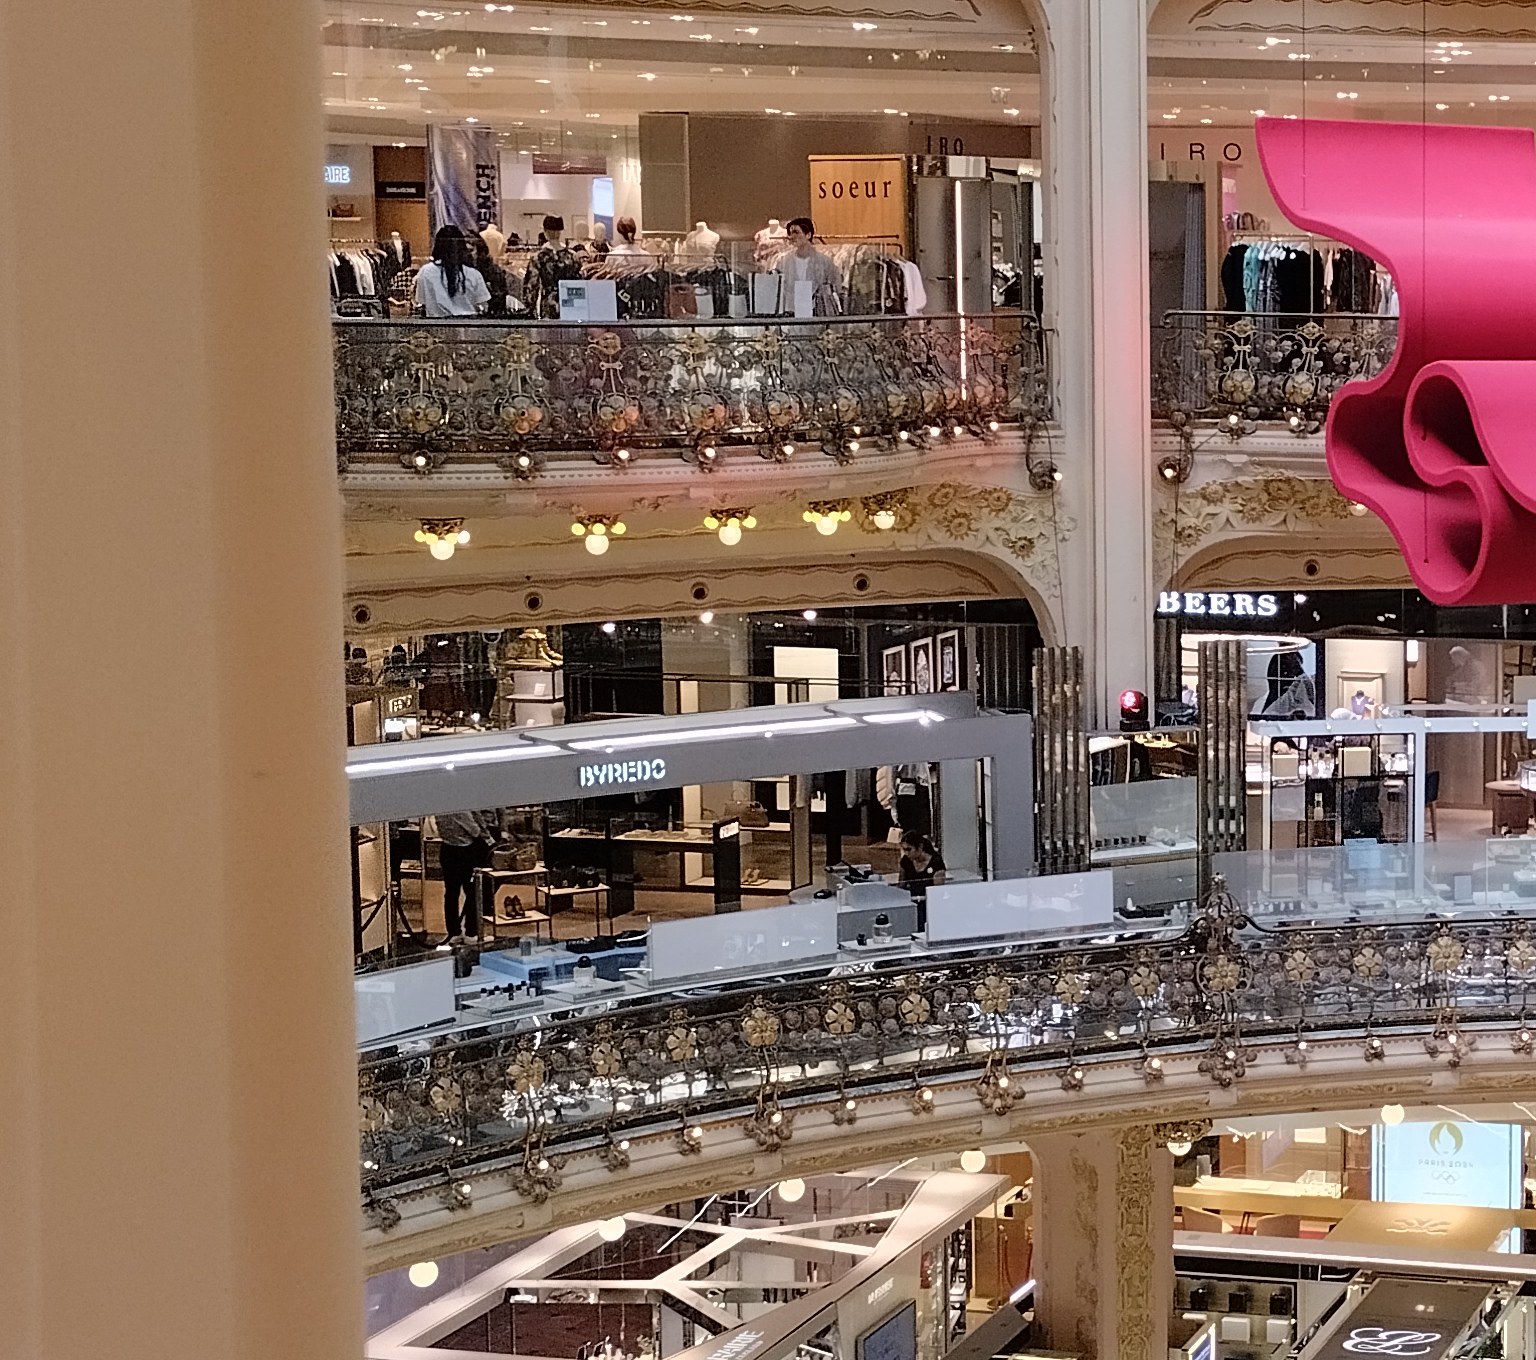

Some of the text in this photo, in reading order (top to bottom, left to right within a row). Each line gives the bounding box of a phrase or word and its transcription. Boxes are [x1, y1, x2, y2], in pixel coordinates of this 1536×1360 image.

[927, 136, 963, 155] IRO
[1161, 143, 1241, 161] IRO
[818, 181, 891, 199] soeur
[1157, 591, 1277, 616] BEERS
[581, 758, 666, 788] BYREDO
[1418, 1158, 1474, 1168] PARIS 2024
